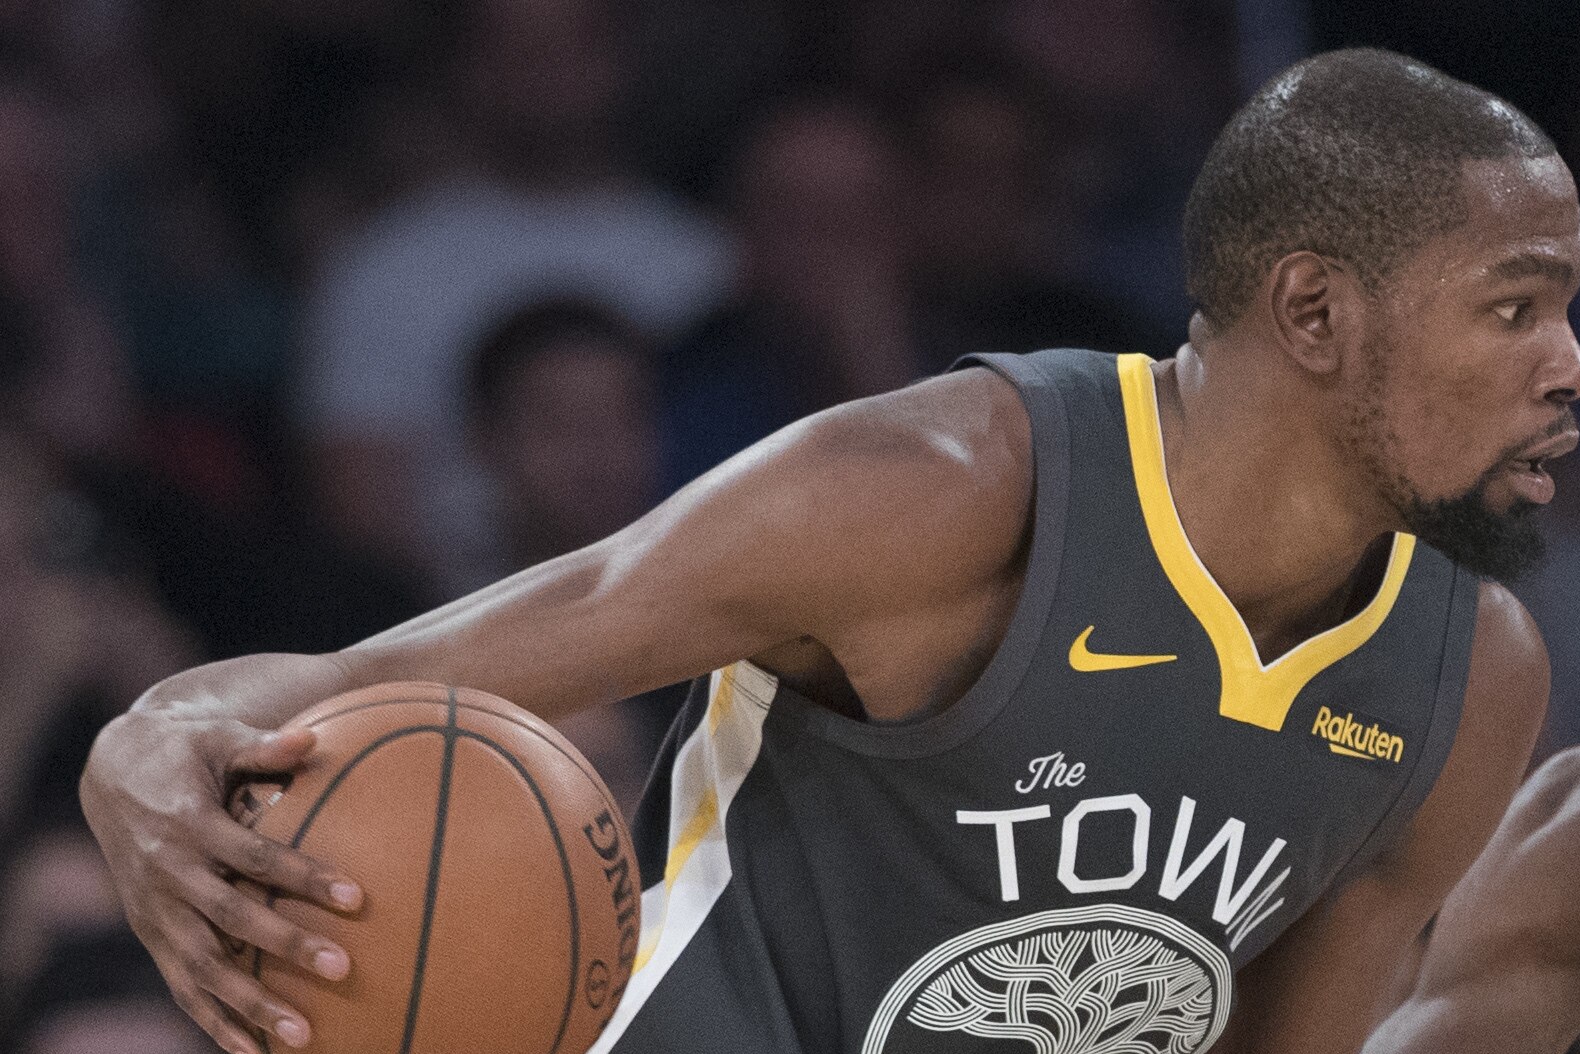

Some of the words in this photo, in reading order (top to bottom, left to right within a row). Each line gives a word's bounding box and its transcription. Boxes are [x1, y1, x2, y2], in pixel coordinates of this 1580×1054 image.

[1311, 705, 1404, 763] Rakuten
[1015, 751, 1086, 794] The
[956, 793, 1291, 953] TOWN
